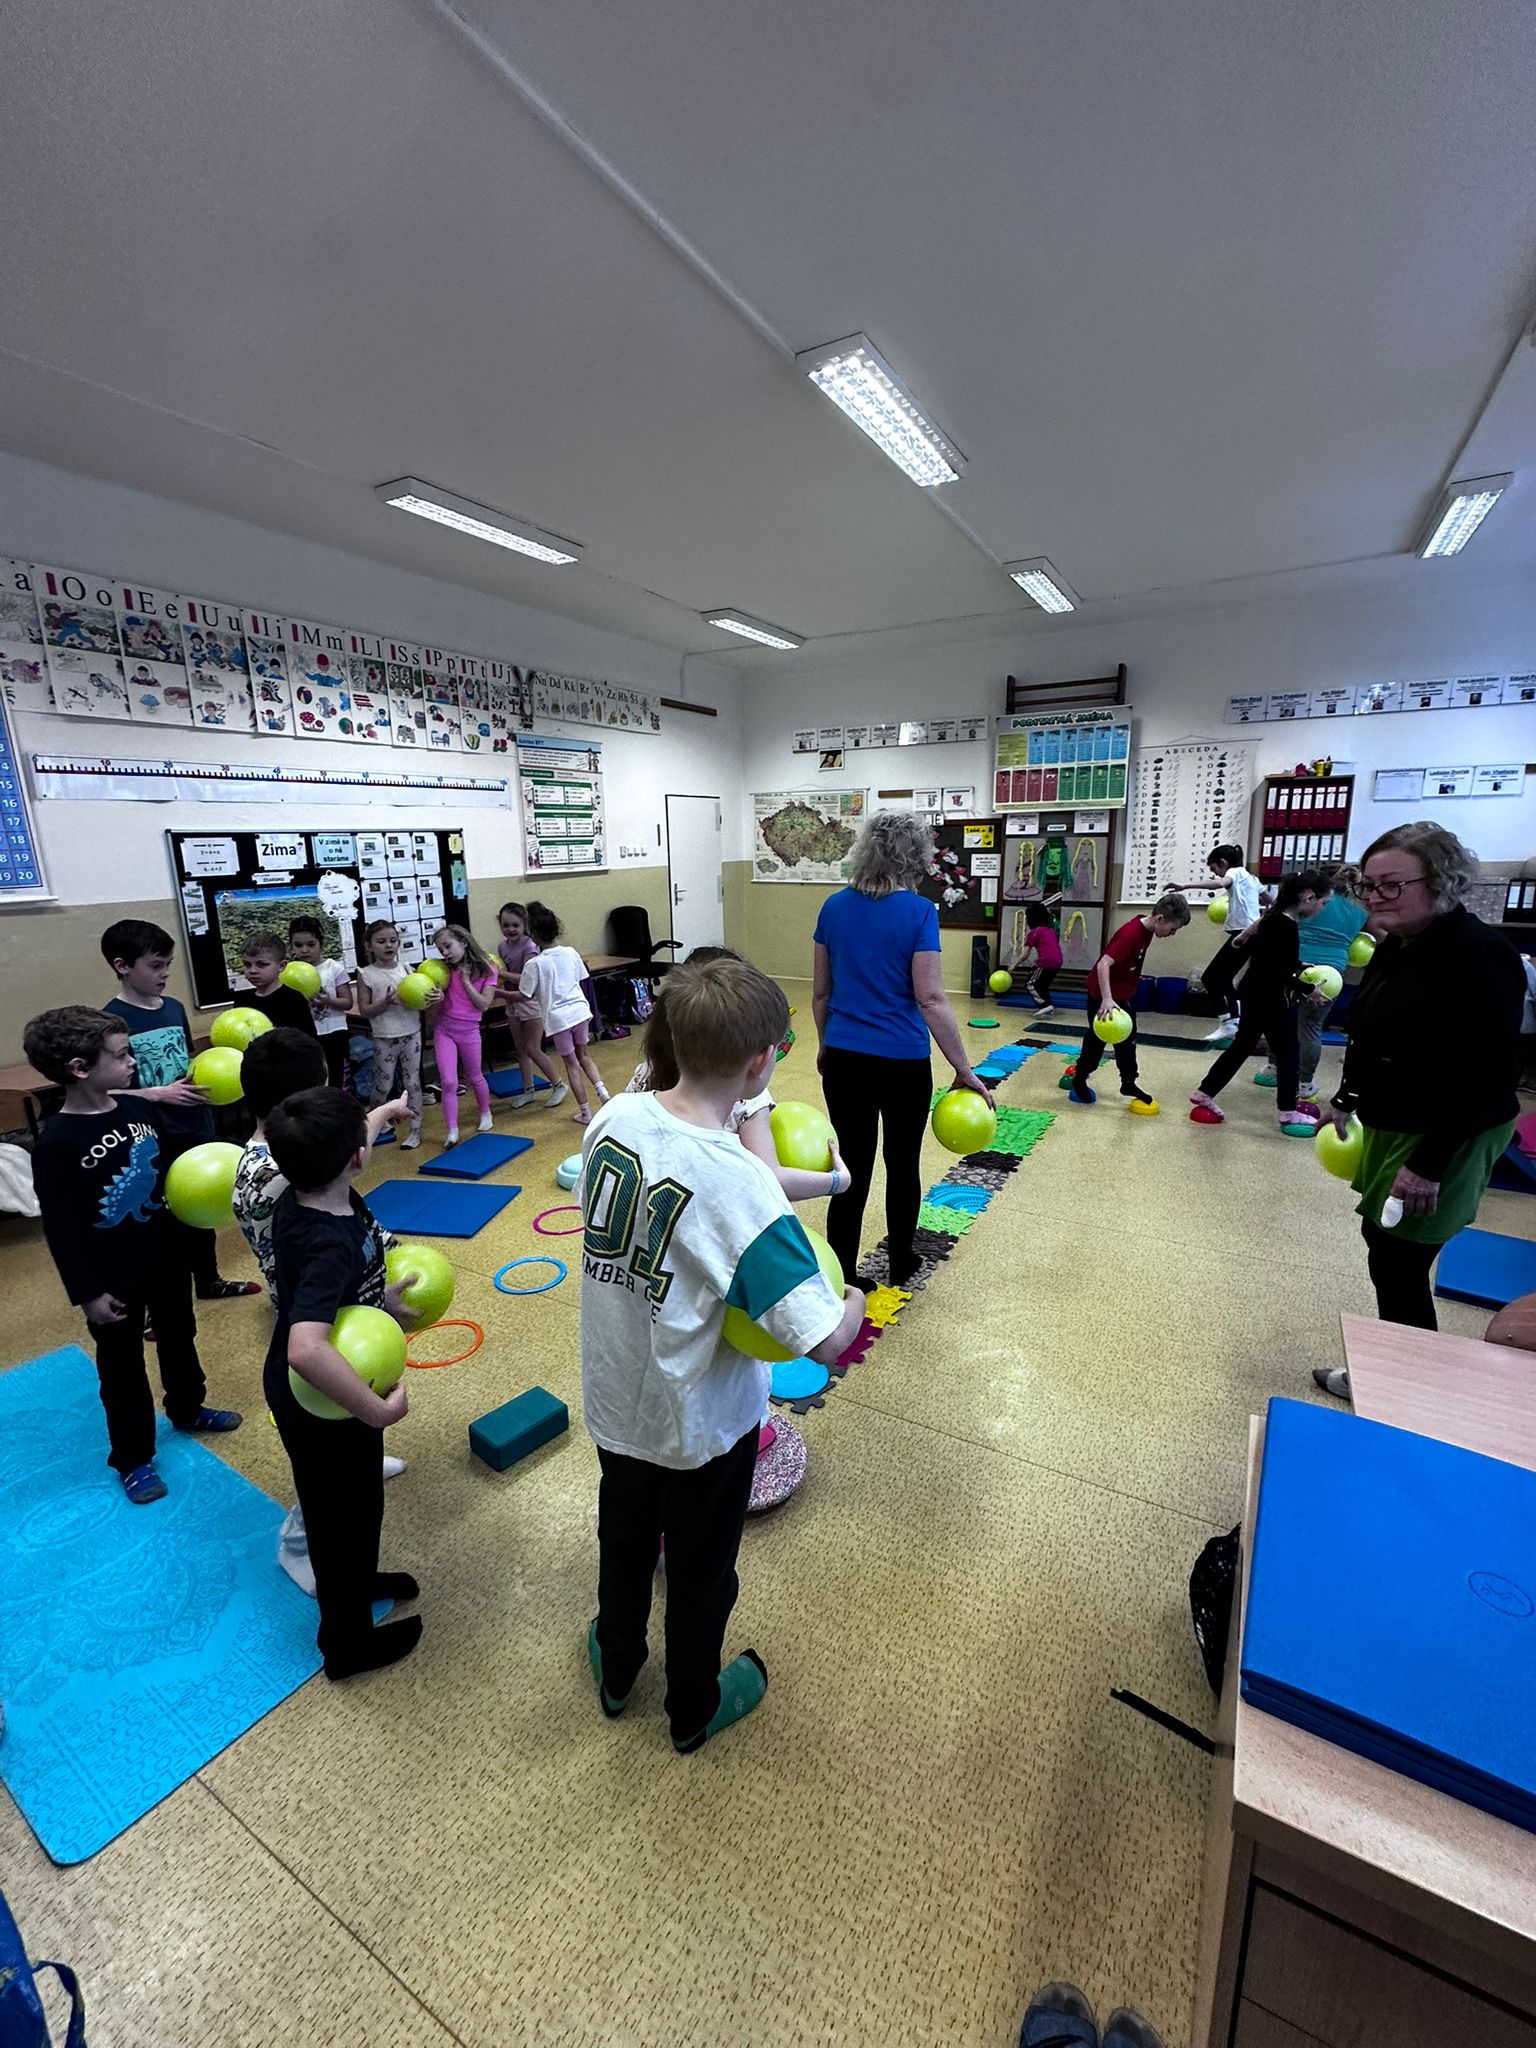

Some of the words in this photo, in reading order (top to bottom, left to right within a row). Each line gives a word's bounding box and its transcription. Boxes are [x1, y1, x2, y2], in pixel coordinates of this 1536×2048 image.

[14, 573, 32, 591] a
[163, 760, 174, 768] 20
[220, 764, 230, 772] 30
[3, 799, 18, 808] 16
[7, 818, 20, 826] 17
[11, 835, 26, 844] 18
[261, 842, 297, 856] Zima
[14, 853, 30, 862] 19
[19, 871, 34, 880] 20
[81, 1129, 128, 1168] COOL
[583, 1135, 694, 1305] 01
